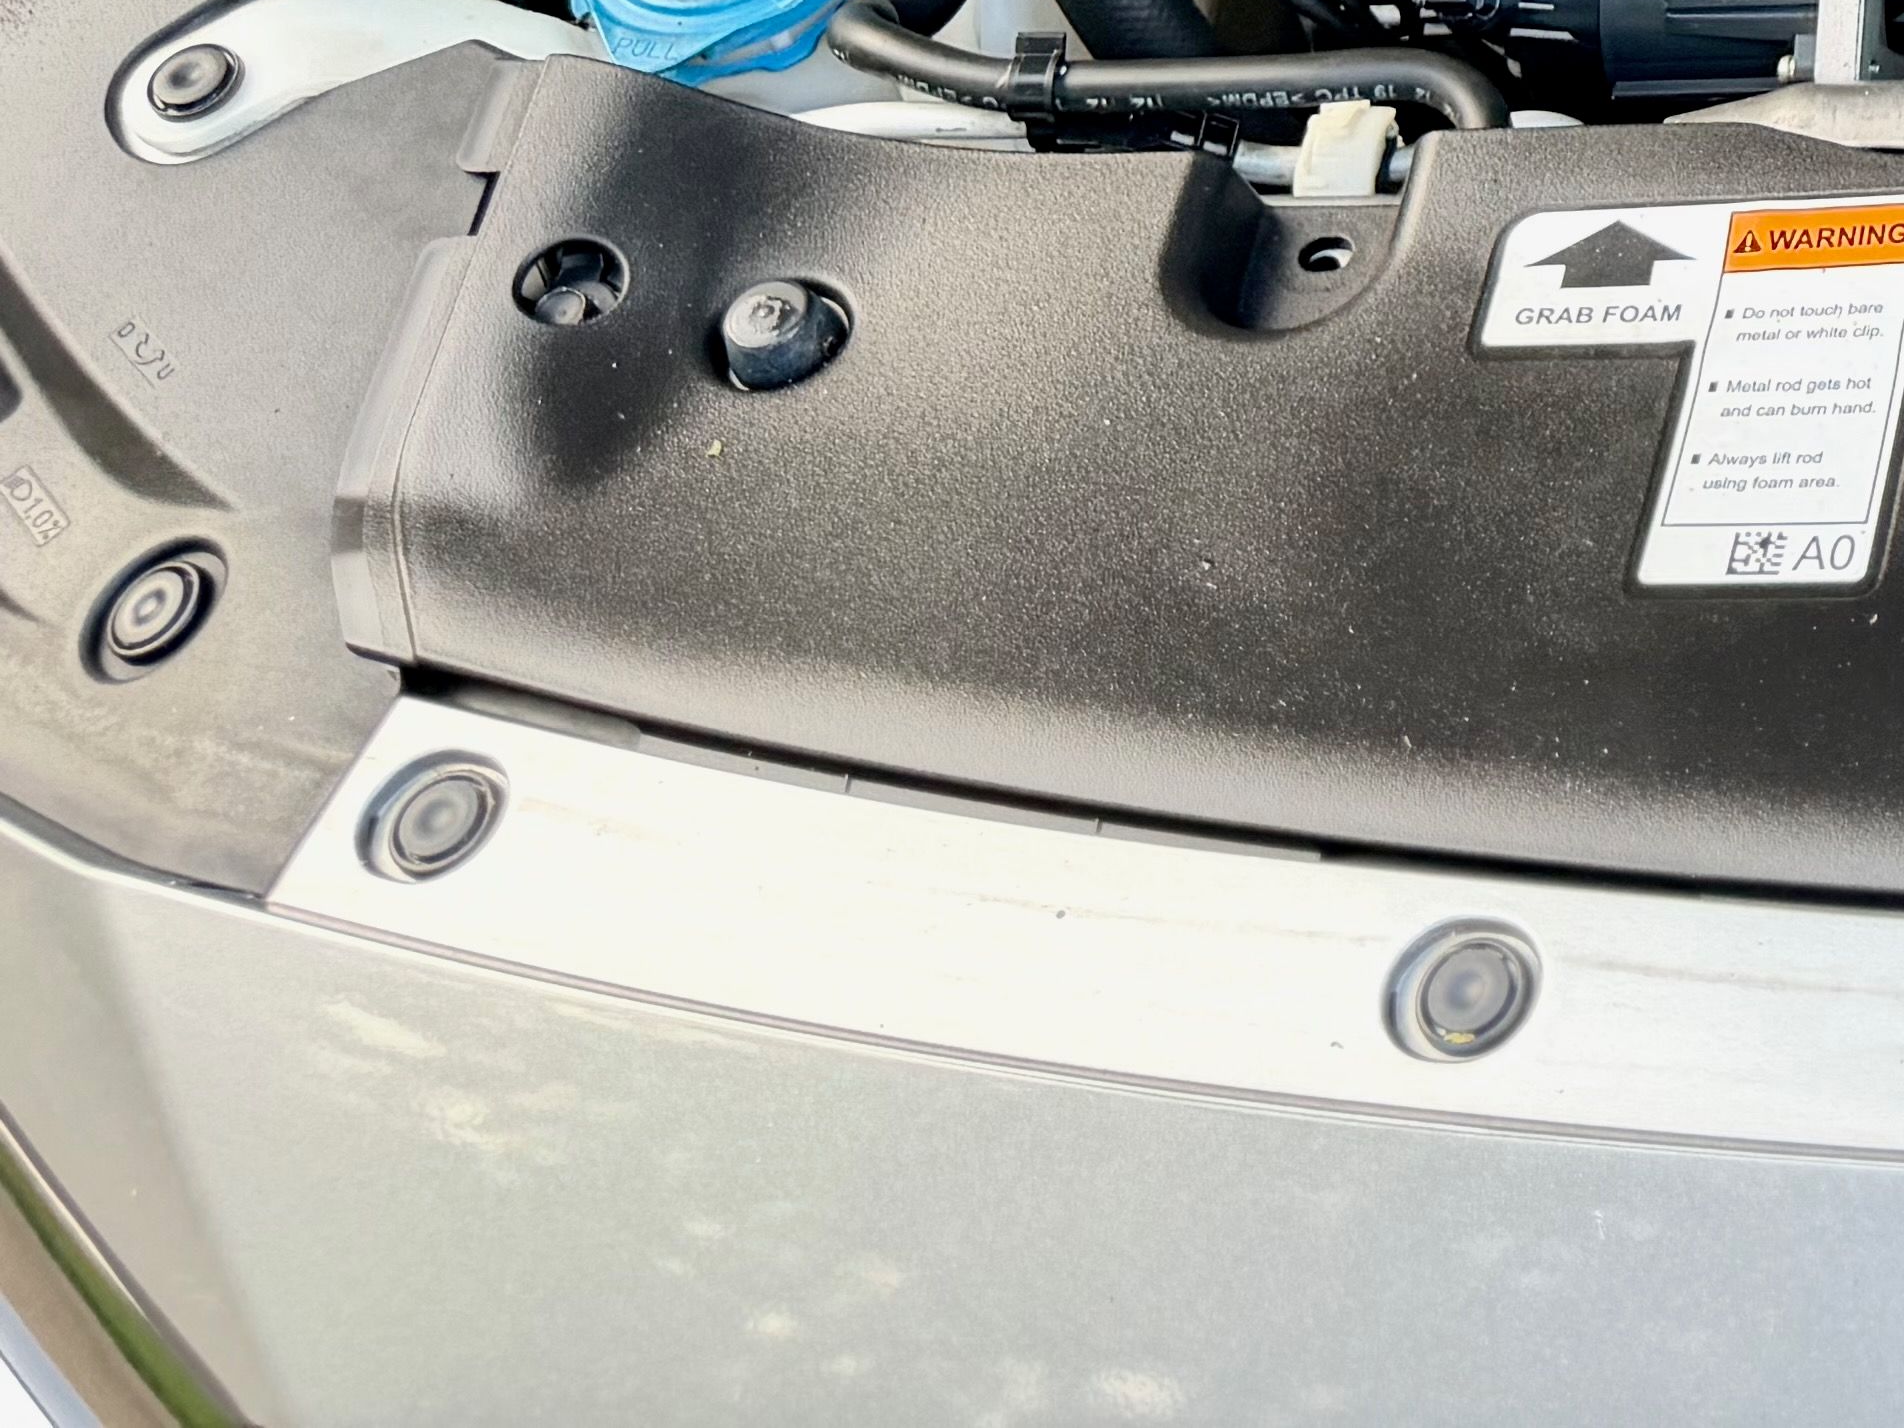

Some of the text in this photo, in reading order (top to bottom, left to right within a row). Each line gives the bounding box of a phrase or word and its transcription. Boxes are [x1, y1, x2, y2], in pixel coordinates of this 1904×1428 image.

[613, 37, 680, 62] PULL
[1515, 304, 1683, 326] GRAB FOAM
[1742, 302, 1884, 320] Do not touch bare
[1736, 325, 1885, 342] metal or white clip.
[1726, 377, 1872, 394] Metal rod gets hot
[1720, 401, 1877, 417] and can burn hand.
[1708, 451, 1823, 469] Always lift rod
[1703, 477, 1840, 492] using foam area.
[1792, 534, 1856, 571] A0
